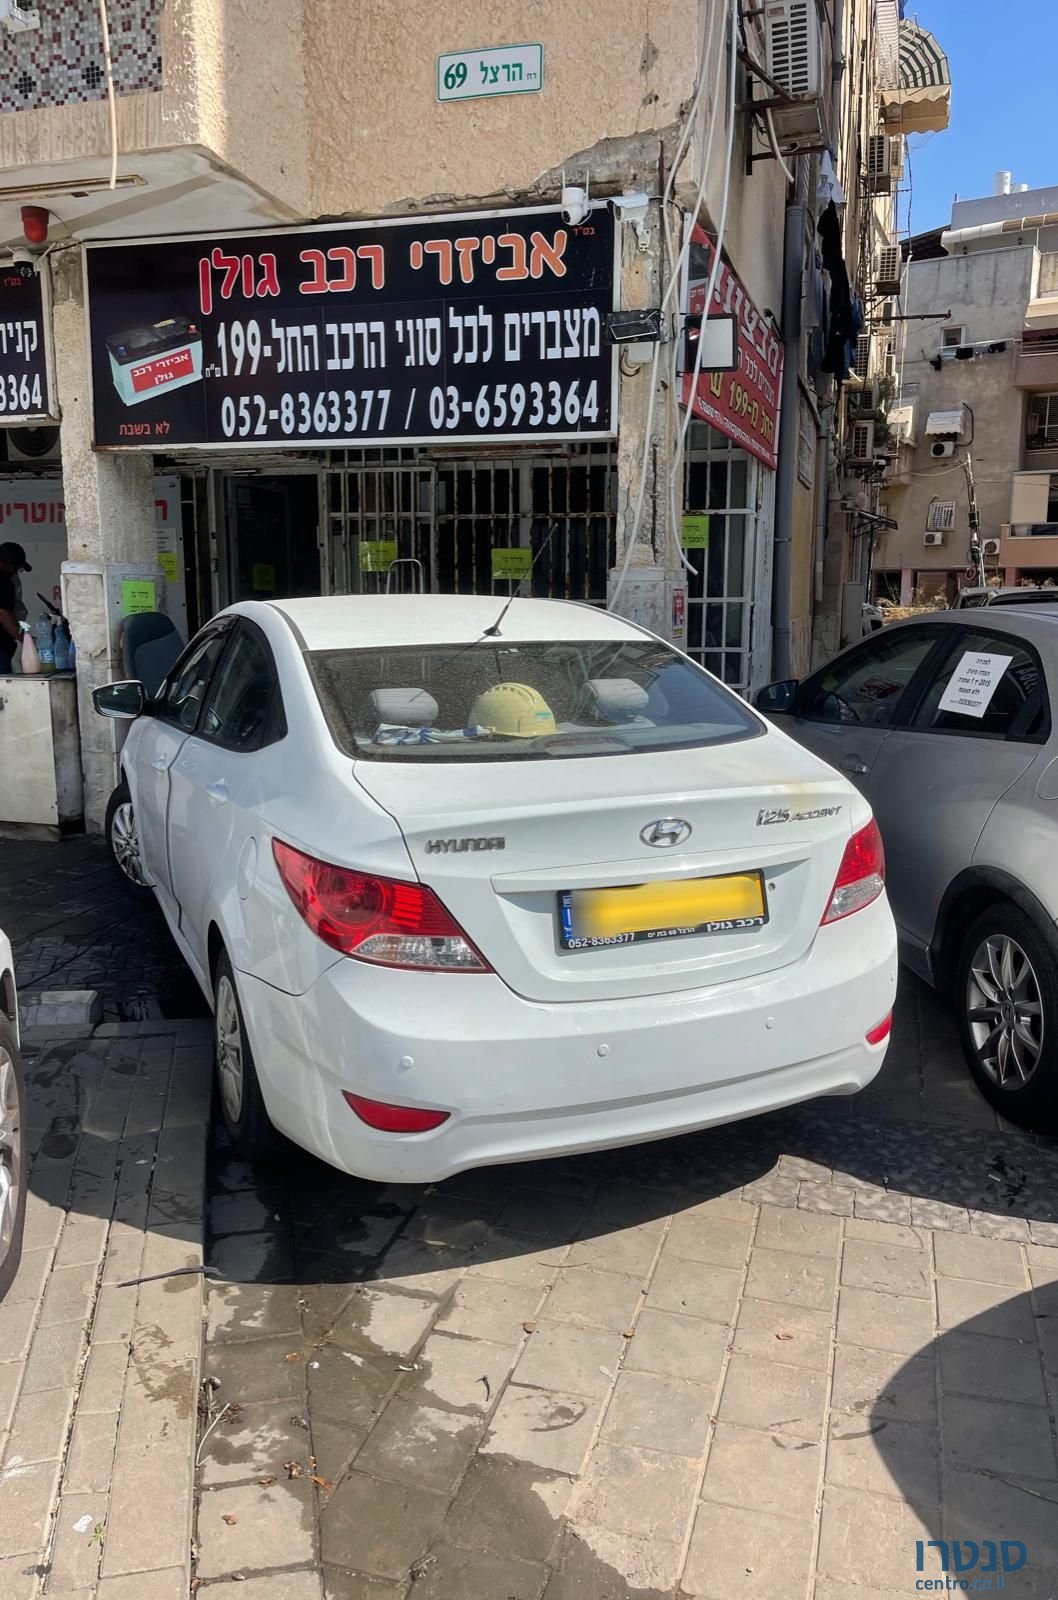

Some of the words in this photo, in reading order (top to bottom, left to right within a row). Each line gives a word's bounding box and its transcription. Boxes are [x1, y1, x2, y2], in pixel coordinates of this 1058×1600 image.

[443, 62, 468, 90] 69
[480, 61, 523, 85] הרצל
[299, 244, 385, 294] רכב
[409, 230, 568, 285] אביזרי
[199, 247, 281, 316] גולן
[325, 321, 387, 370] הרכב
[395, 317, 441, 367] סוגי
[449, 305, 493, 364] לכל
[504, 306, 601, 362] מצברים
[132, 365, 152, 377] רכב
[156, 353, 189, 368] אביזרי
[154, 372, 174, 385] גולן
[221, 389, 391, 438] 052-8363377
[429, 379, 599, 430] 03-6593364
[119, 423, 151, 436] בשבת
[155, 421, 170, 436] לא
[756, 808, 790, 826] i25
[424, 837, 506, 854] HYUNDAI
[707, 919, 733, 932] גולן
[736, 916, 764, 929] רכב
